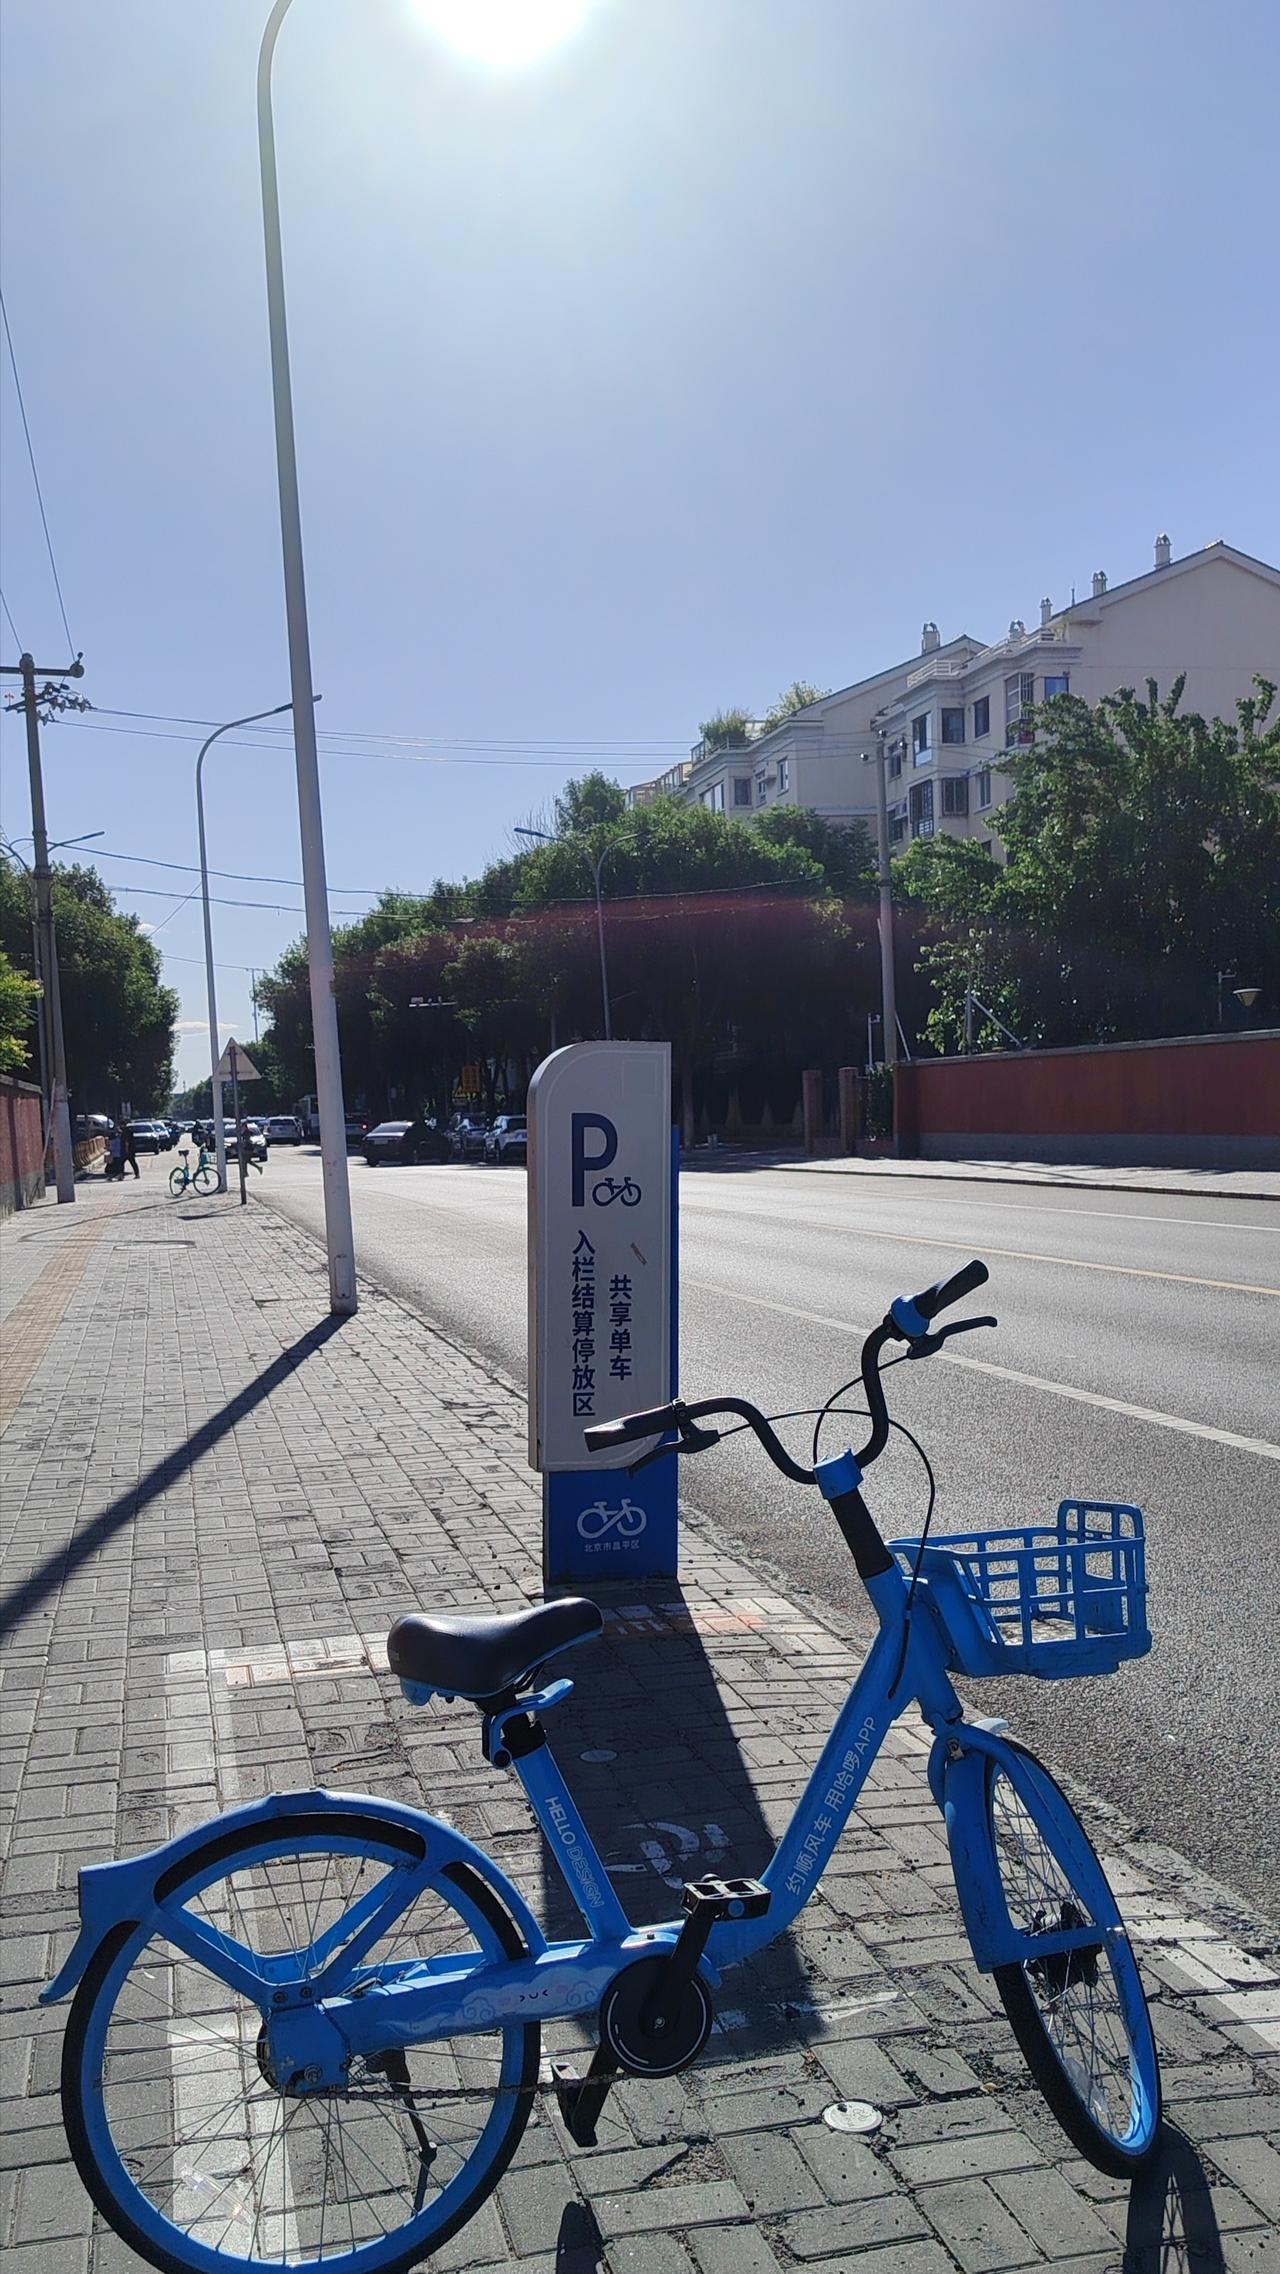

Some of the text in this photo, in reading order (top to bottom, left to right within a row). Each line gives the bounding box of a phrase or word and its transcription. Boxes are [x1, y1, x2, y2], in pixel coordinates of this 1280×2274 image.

[571, 1112, 618, 1207] P
[571, 1229, 596, 1417] 入栏结算停放区
[608, 1274, 632, 1381] 共享单车
[584, 1539, 640, 1552] 北京市昌平区
[545, 1796, 605, 1908] HELLO DESIGN
[785, 1716, 876, 1895] 约顺风车 用哈啰APP
